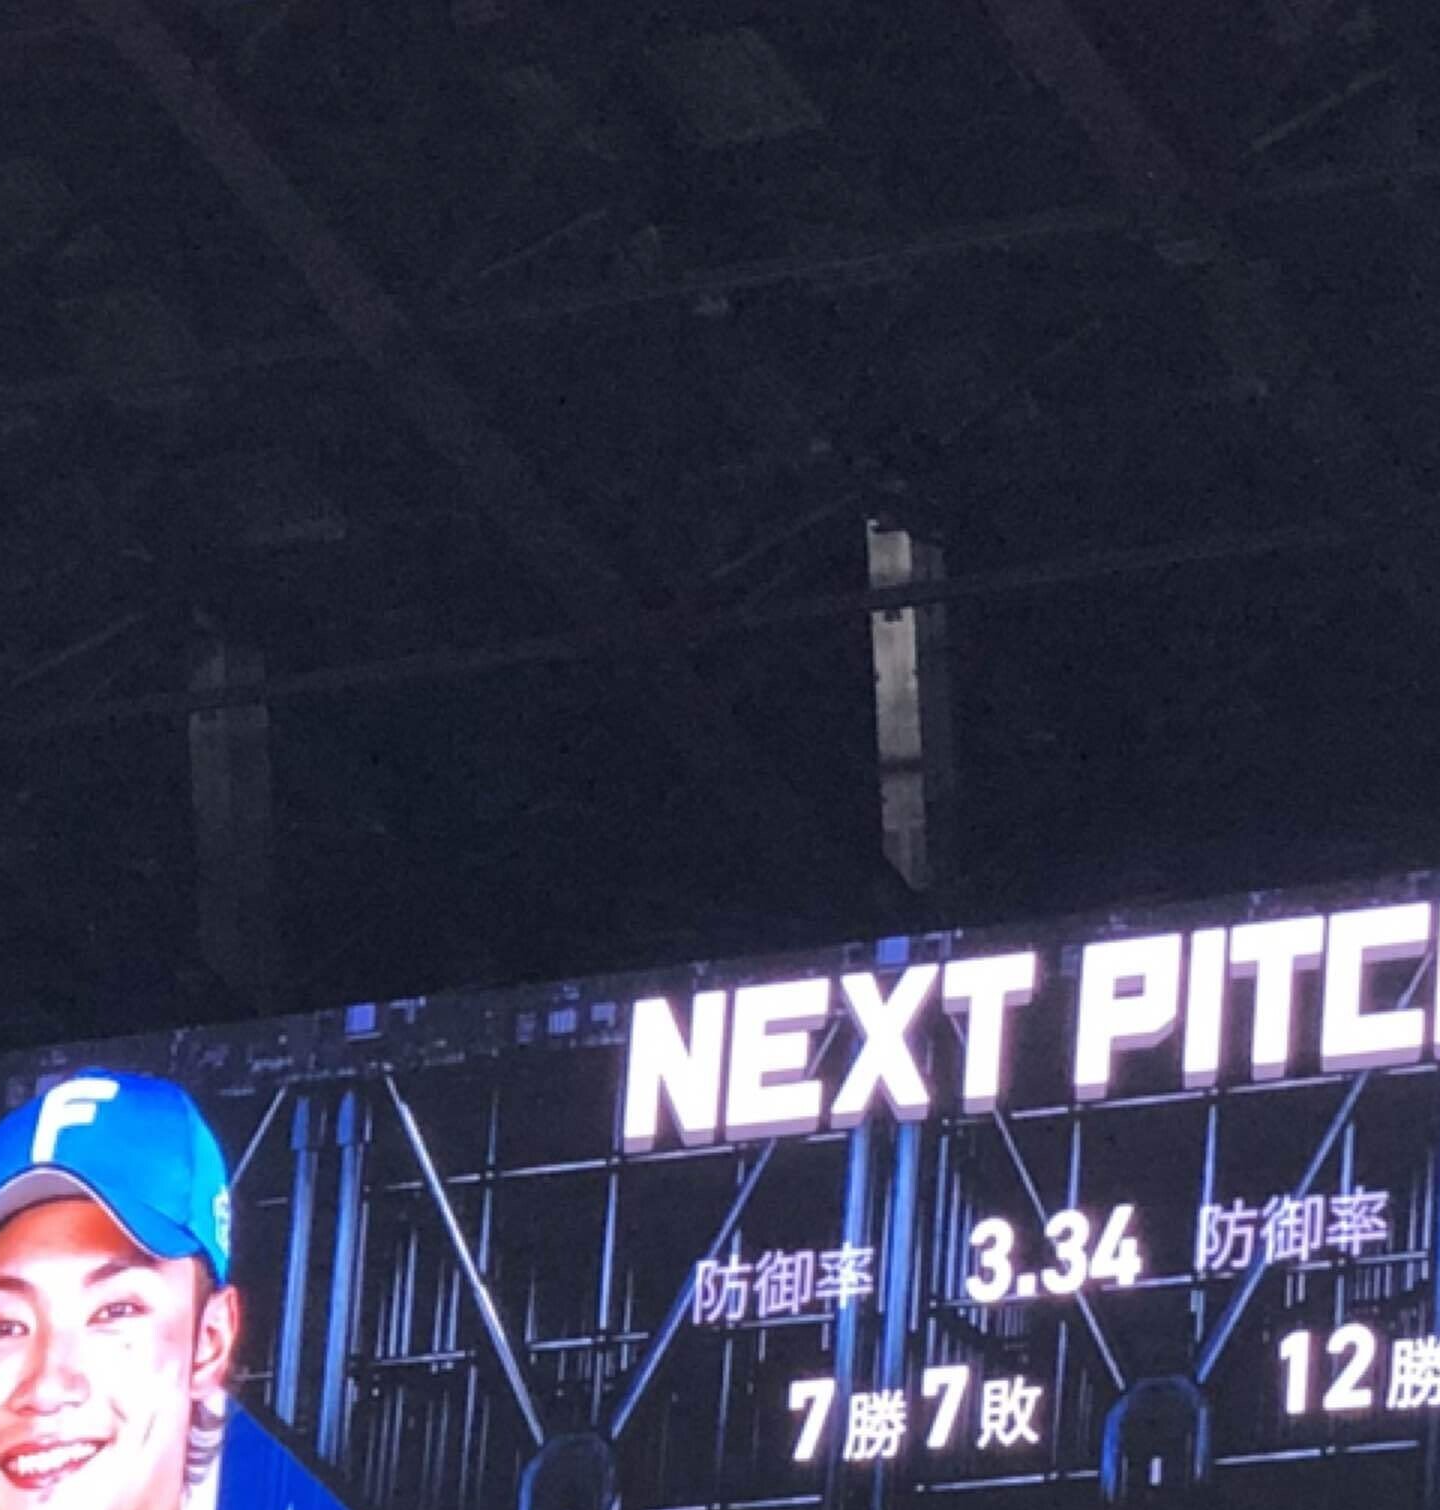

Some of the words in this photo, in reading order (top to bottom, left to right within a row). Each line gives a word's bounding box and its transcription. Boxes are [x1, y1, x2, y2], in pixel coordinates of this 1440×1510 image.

[623, 951, 1036, 1153] NEXT
[33, 1078, 118, 1163] F
[694, 1240, 874, 1325] 防御率
[965, 1204, 1144, 1302] 3.34
[1197, 1186, 1391, 1271] 防御率
